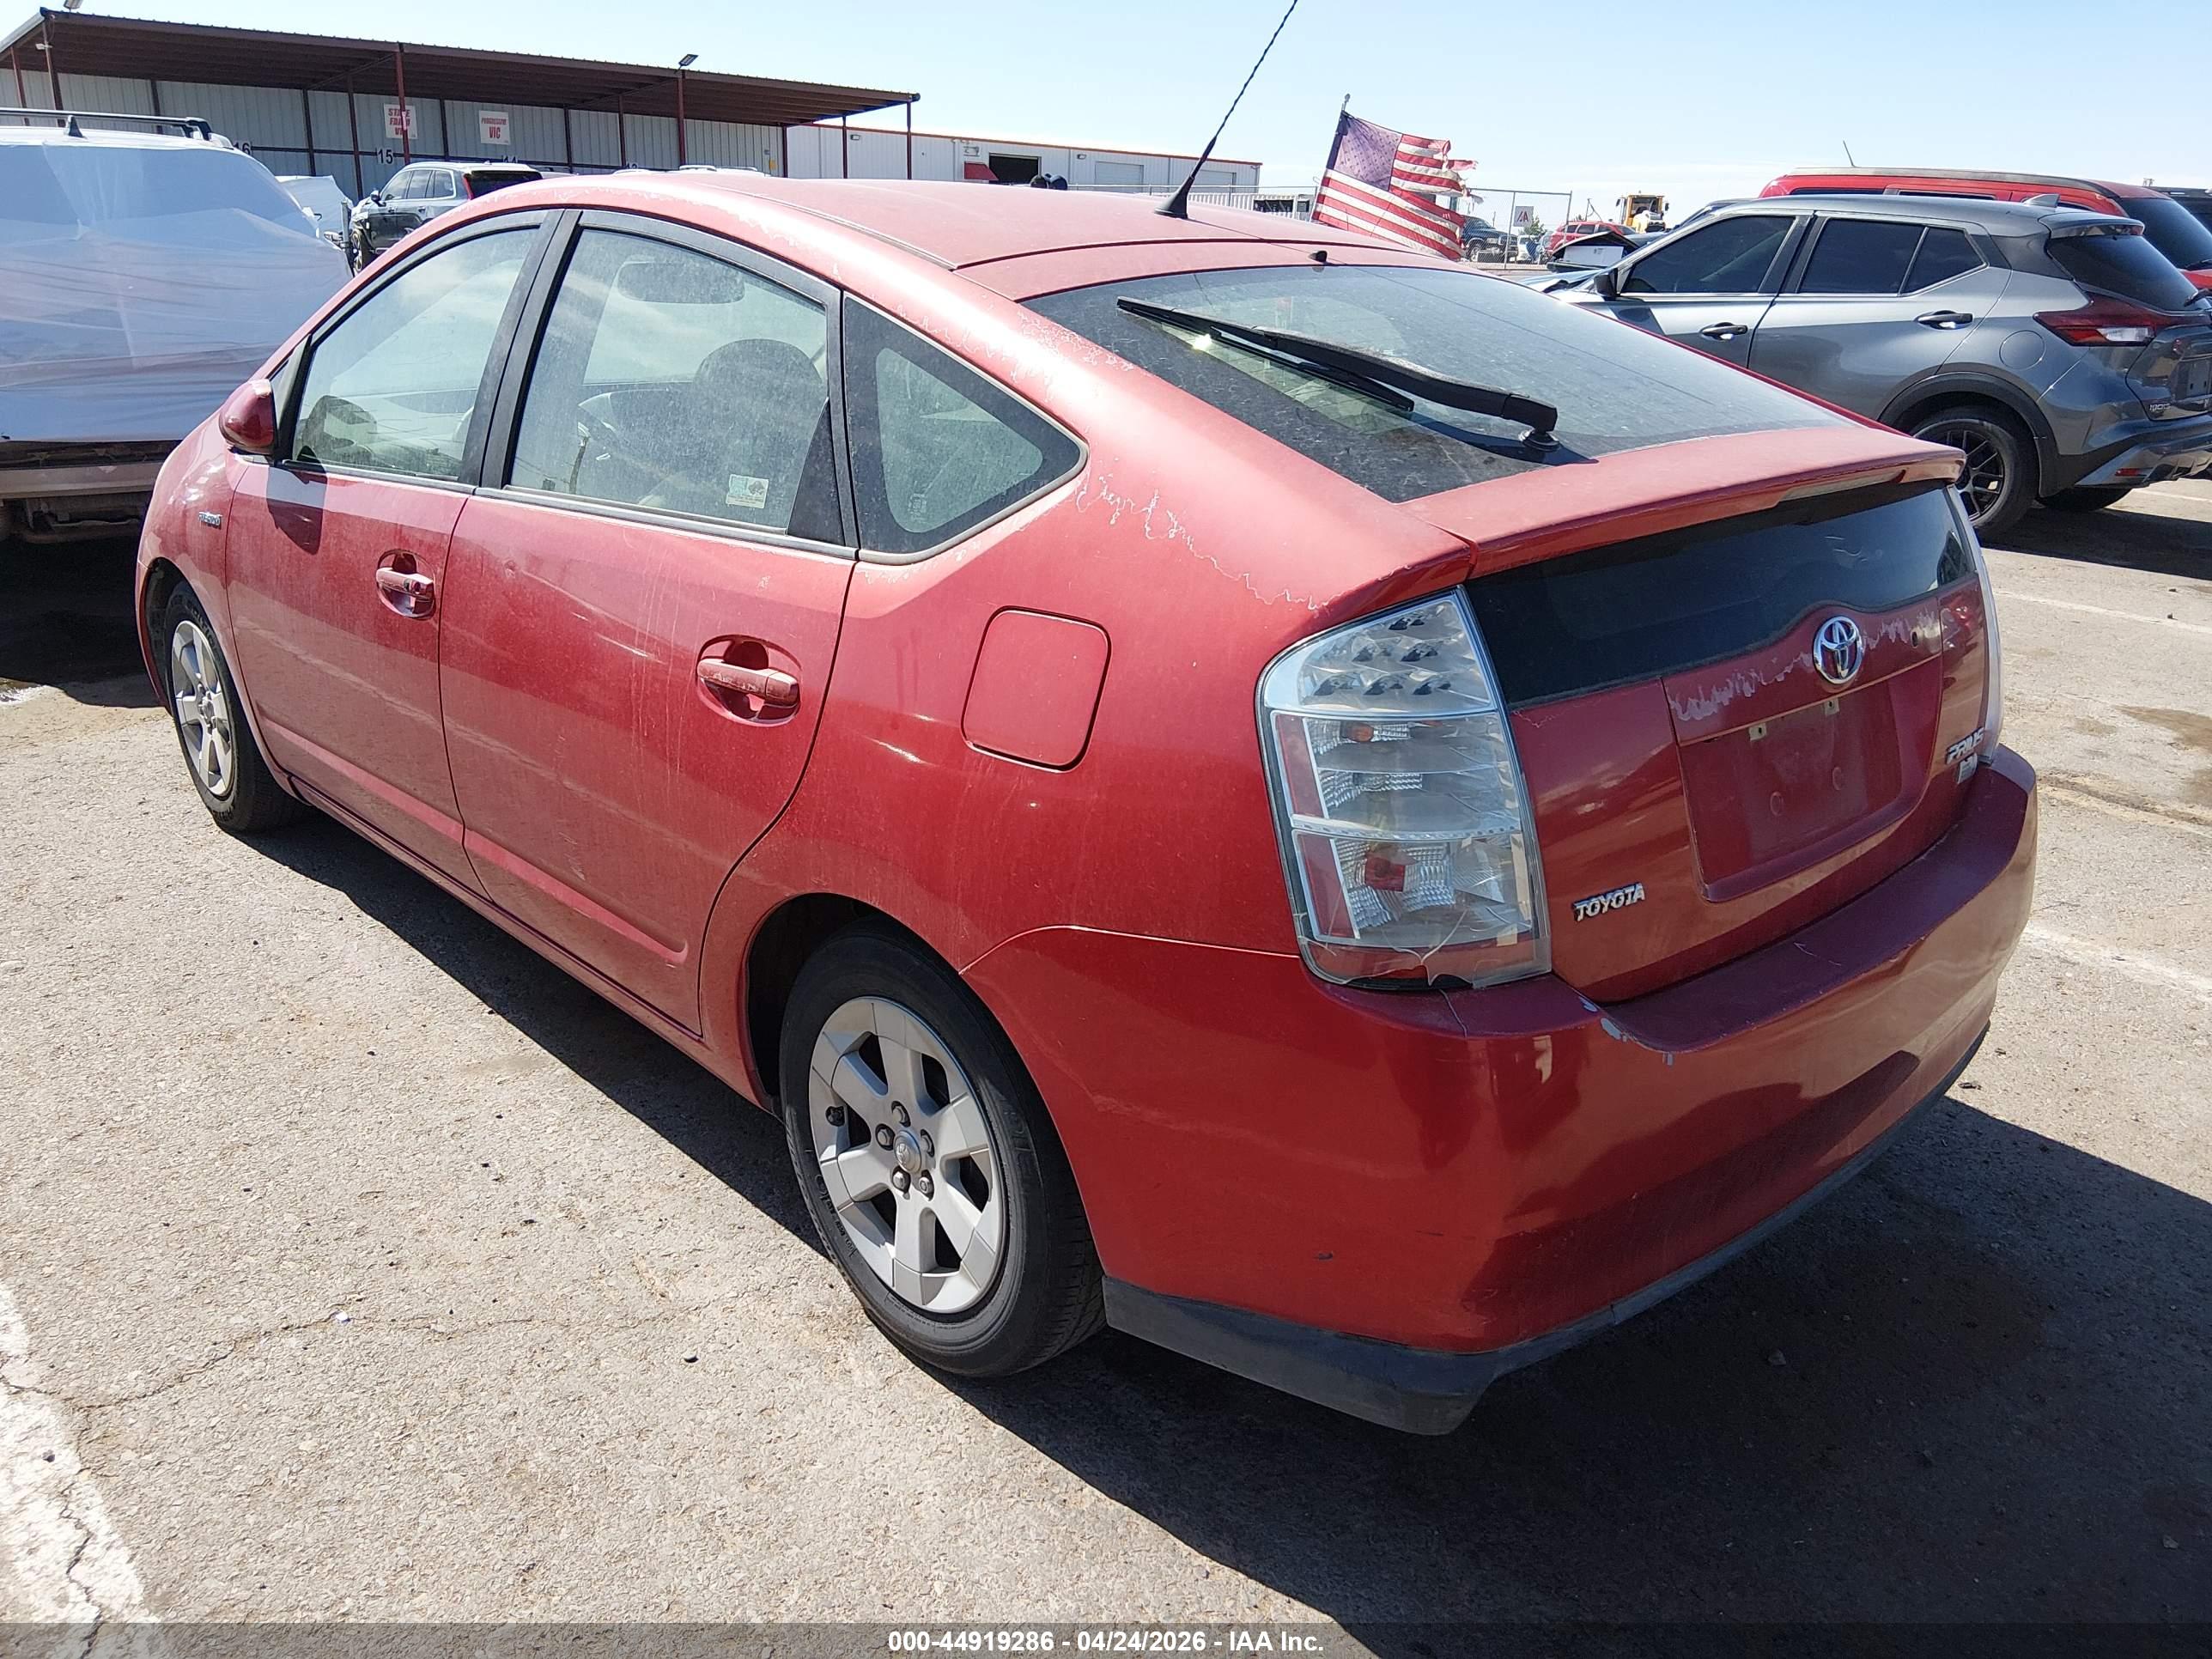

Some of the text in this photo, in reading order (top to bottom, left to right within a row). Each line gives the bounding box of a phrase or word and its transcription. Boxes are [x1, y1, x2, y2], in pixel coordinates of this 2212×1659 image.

[388, 108, 410, 118] STAE
[489, 126, 501, 138] VIC
[378, 149, 393, 164] 15
[1946, 726, 1984, 764] PRIUS
[1573, 883, 1645, 922] TOYOTA
